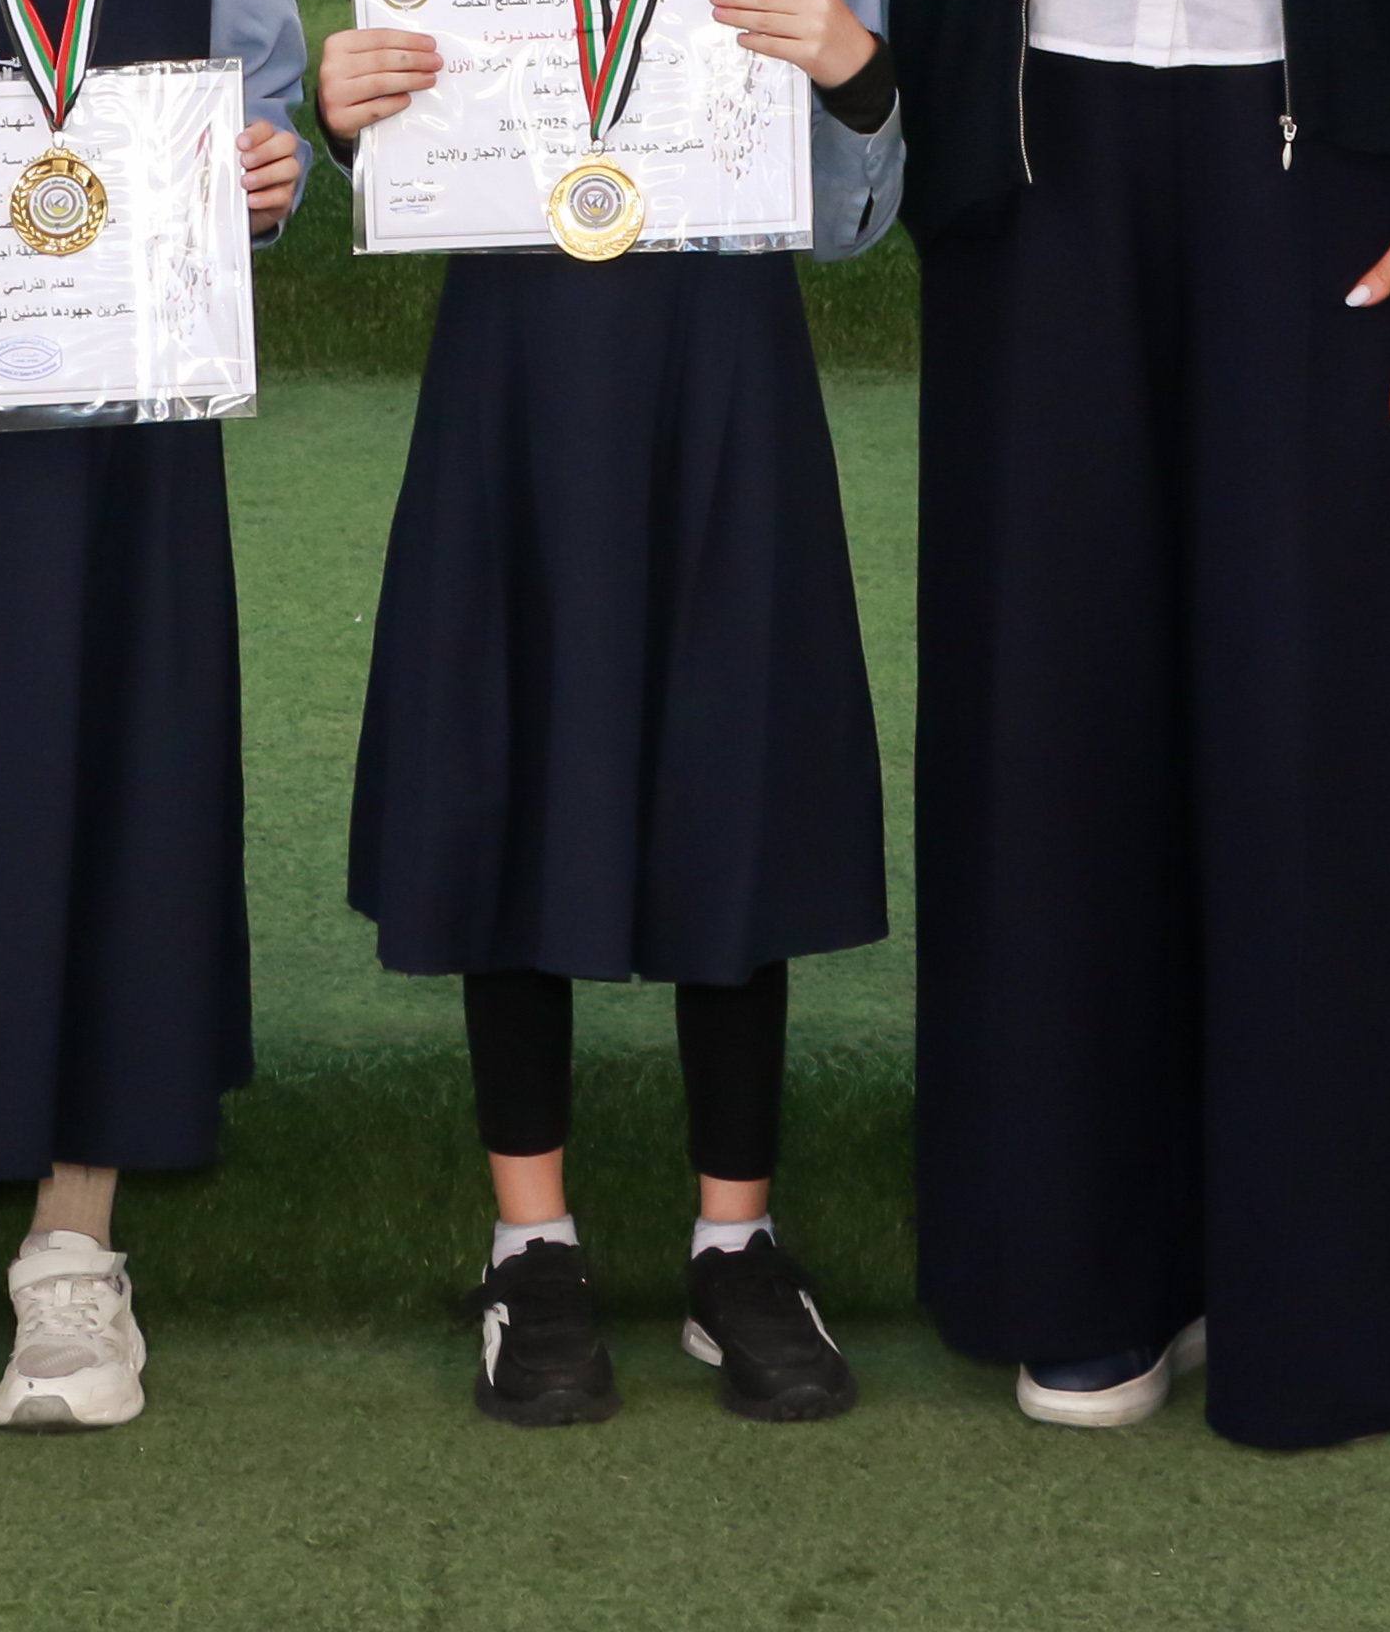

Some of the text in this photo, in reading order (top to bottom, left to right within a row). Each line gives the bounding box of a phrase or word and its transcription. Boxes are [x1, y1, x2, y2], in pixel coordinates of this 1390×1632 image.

[527, 31, 555, 41] محمد
[619, 141, 660, 155] جهودها
[664, 138, 704, 154] شاكرين
[510, 147, 526, 160] من
[50, 305, 93, 319] جهودها
